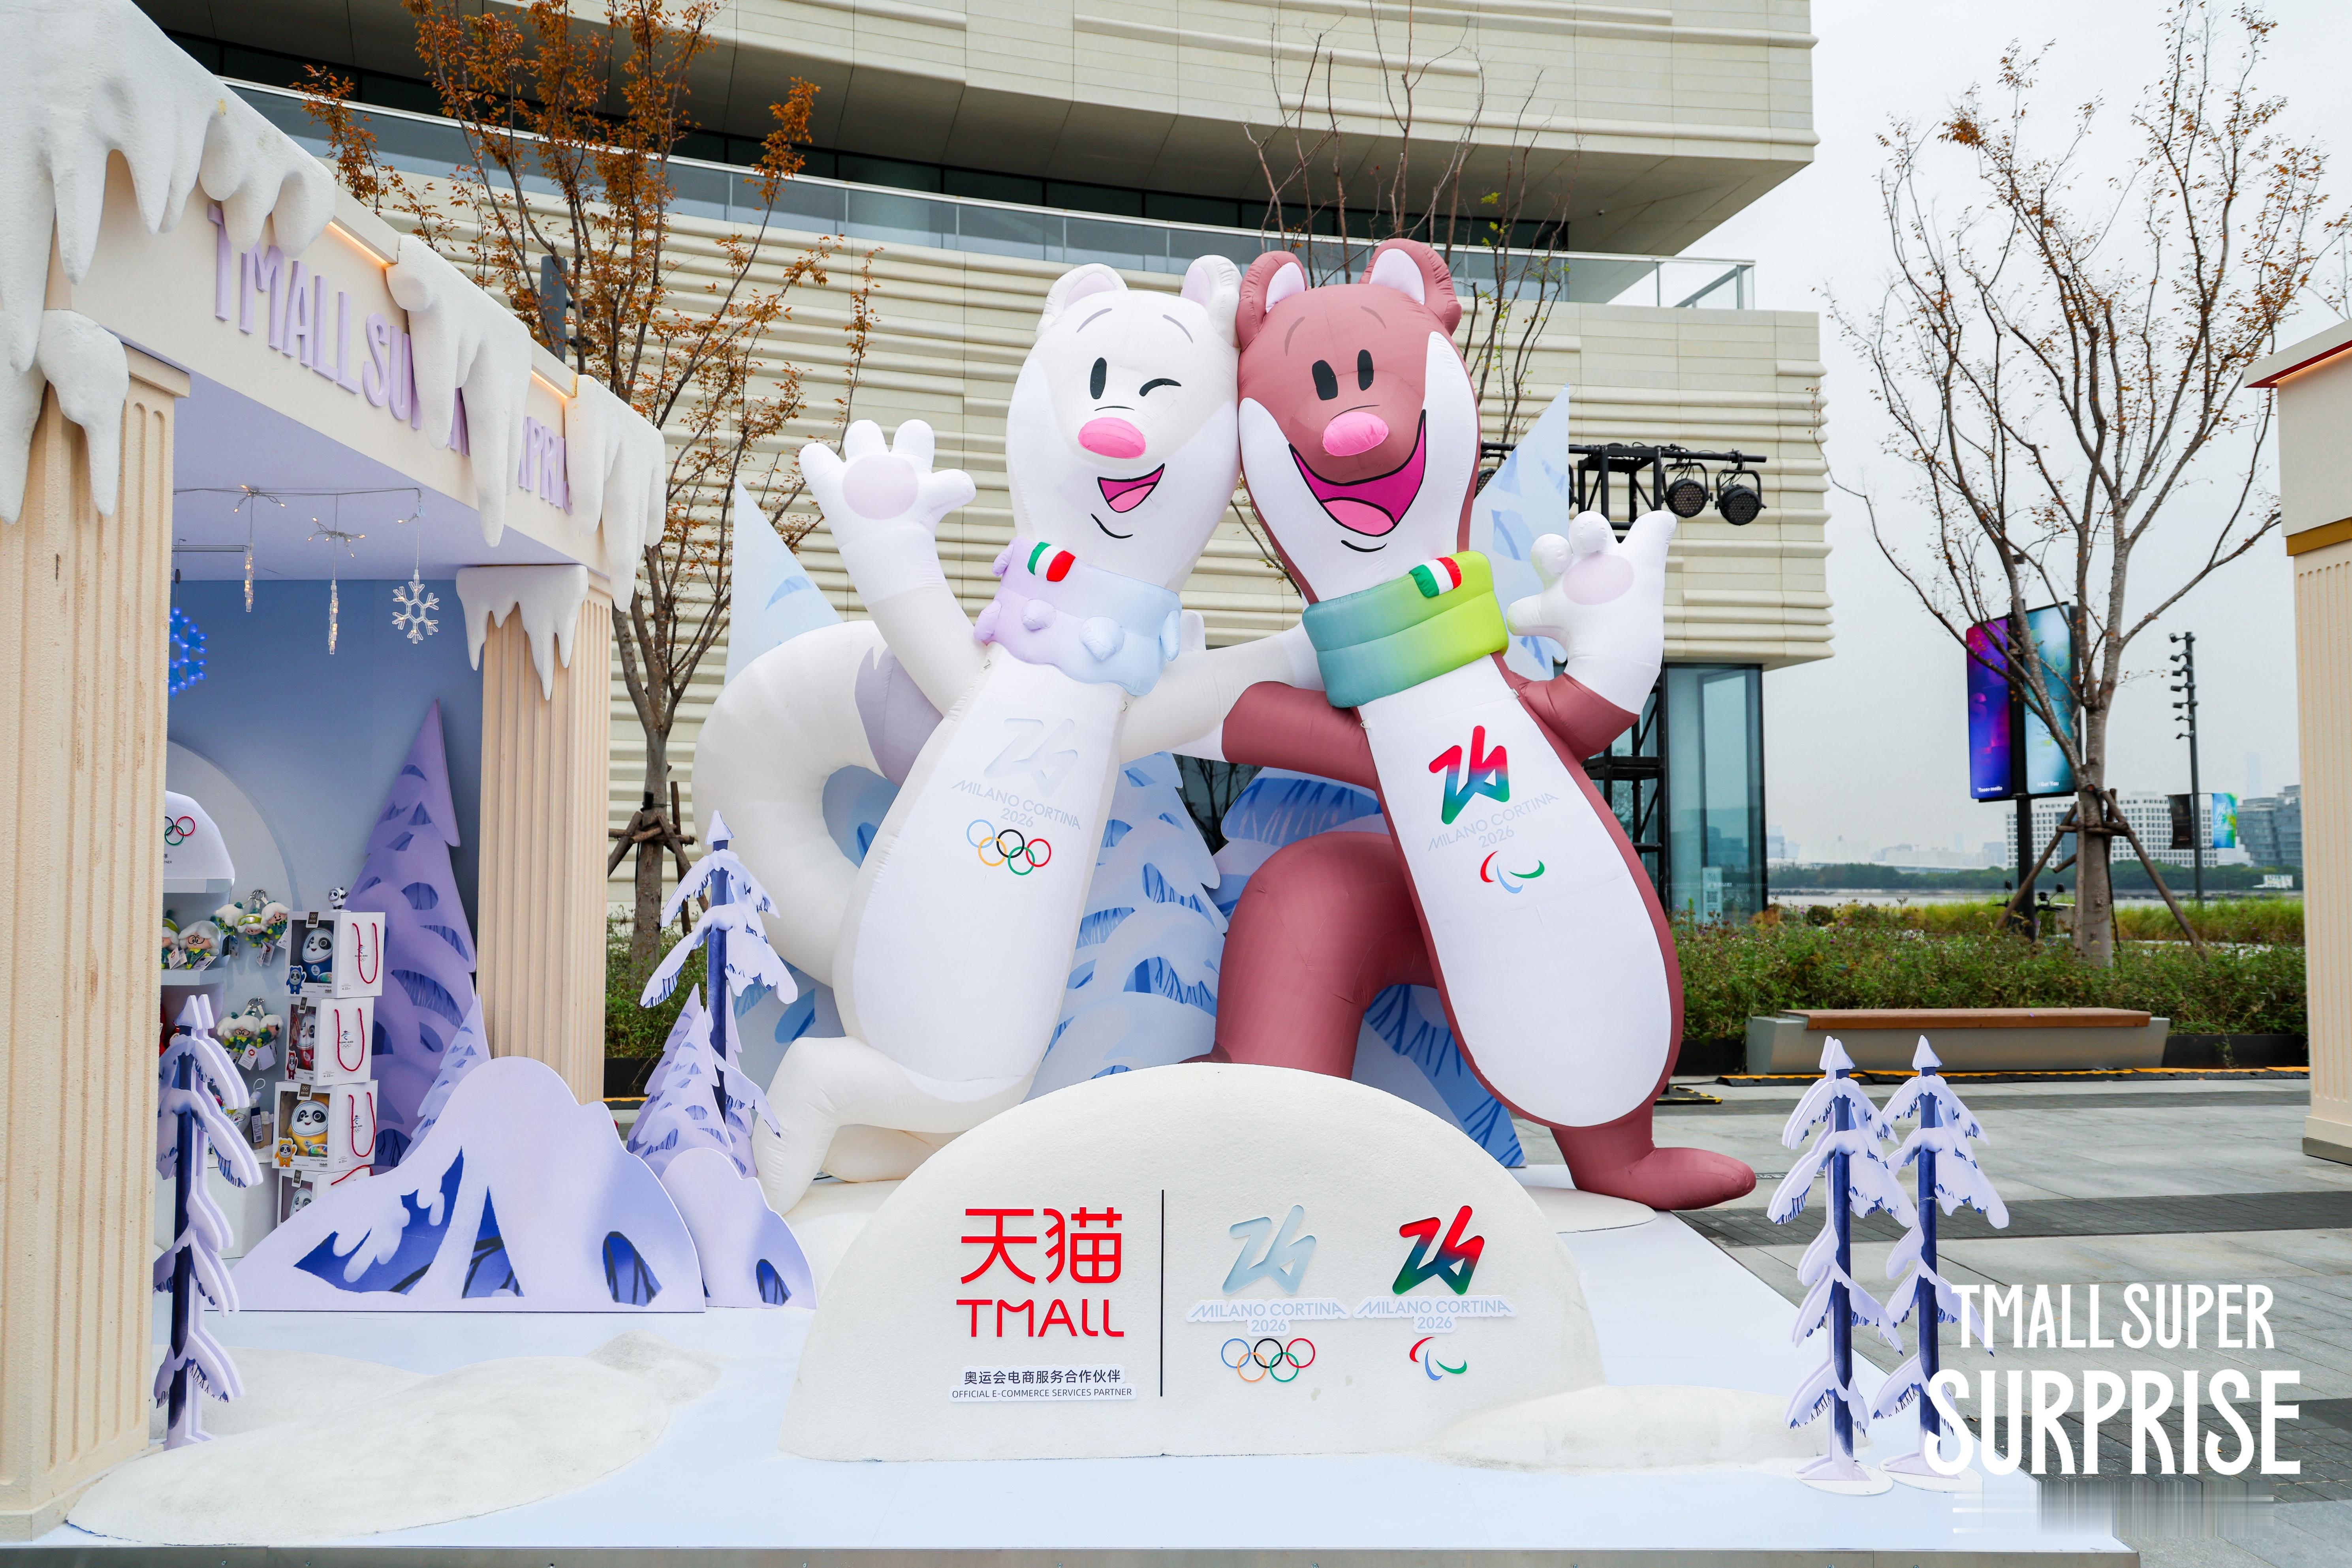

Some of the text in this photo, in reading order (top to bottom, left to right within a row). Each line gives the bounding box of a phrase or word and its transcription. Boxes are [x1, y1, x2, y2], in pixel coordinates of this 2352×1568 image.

[208, 203, 360, 394] TMALL
[951, 780, 1081, 830] MILANO CORTINA
[1000, 807, 1034, 828] 2026
[1428, 792, 1559, 851] MILANO CORTINA
[1479, 825, 1514, 848] 2026
[961, 1207, 1122, 1284] 天猫
[956, 1299, 1124, 1337] TMALL
[1190, 1302, 1346, 1318] MILANO CORTINA
[1357, 1300, 1512, 1314] MILANO CORTINA
[1251, 1319, 1286, 1332] 2026
[1417, 1316, 1452, 1329] 2026
[964, 1369, 1121, 1384] 奥运会电商服务合作伙伴
